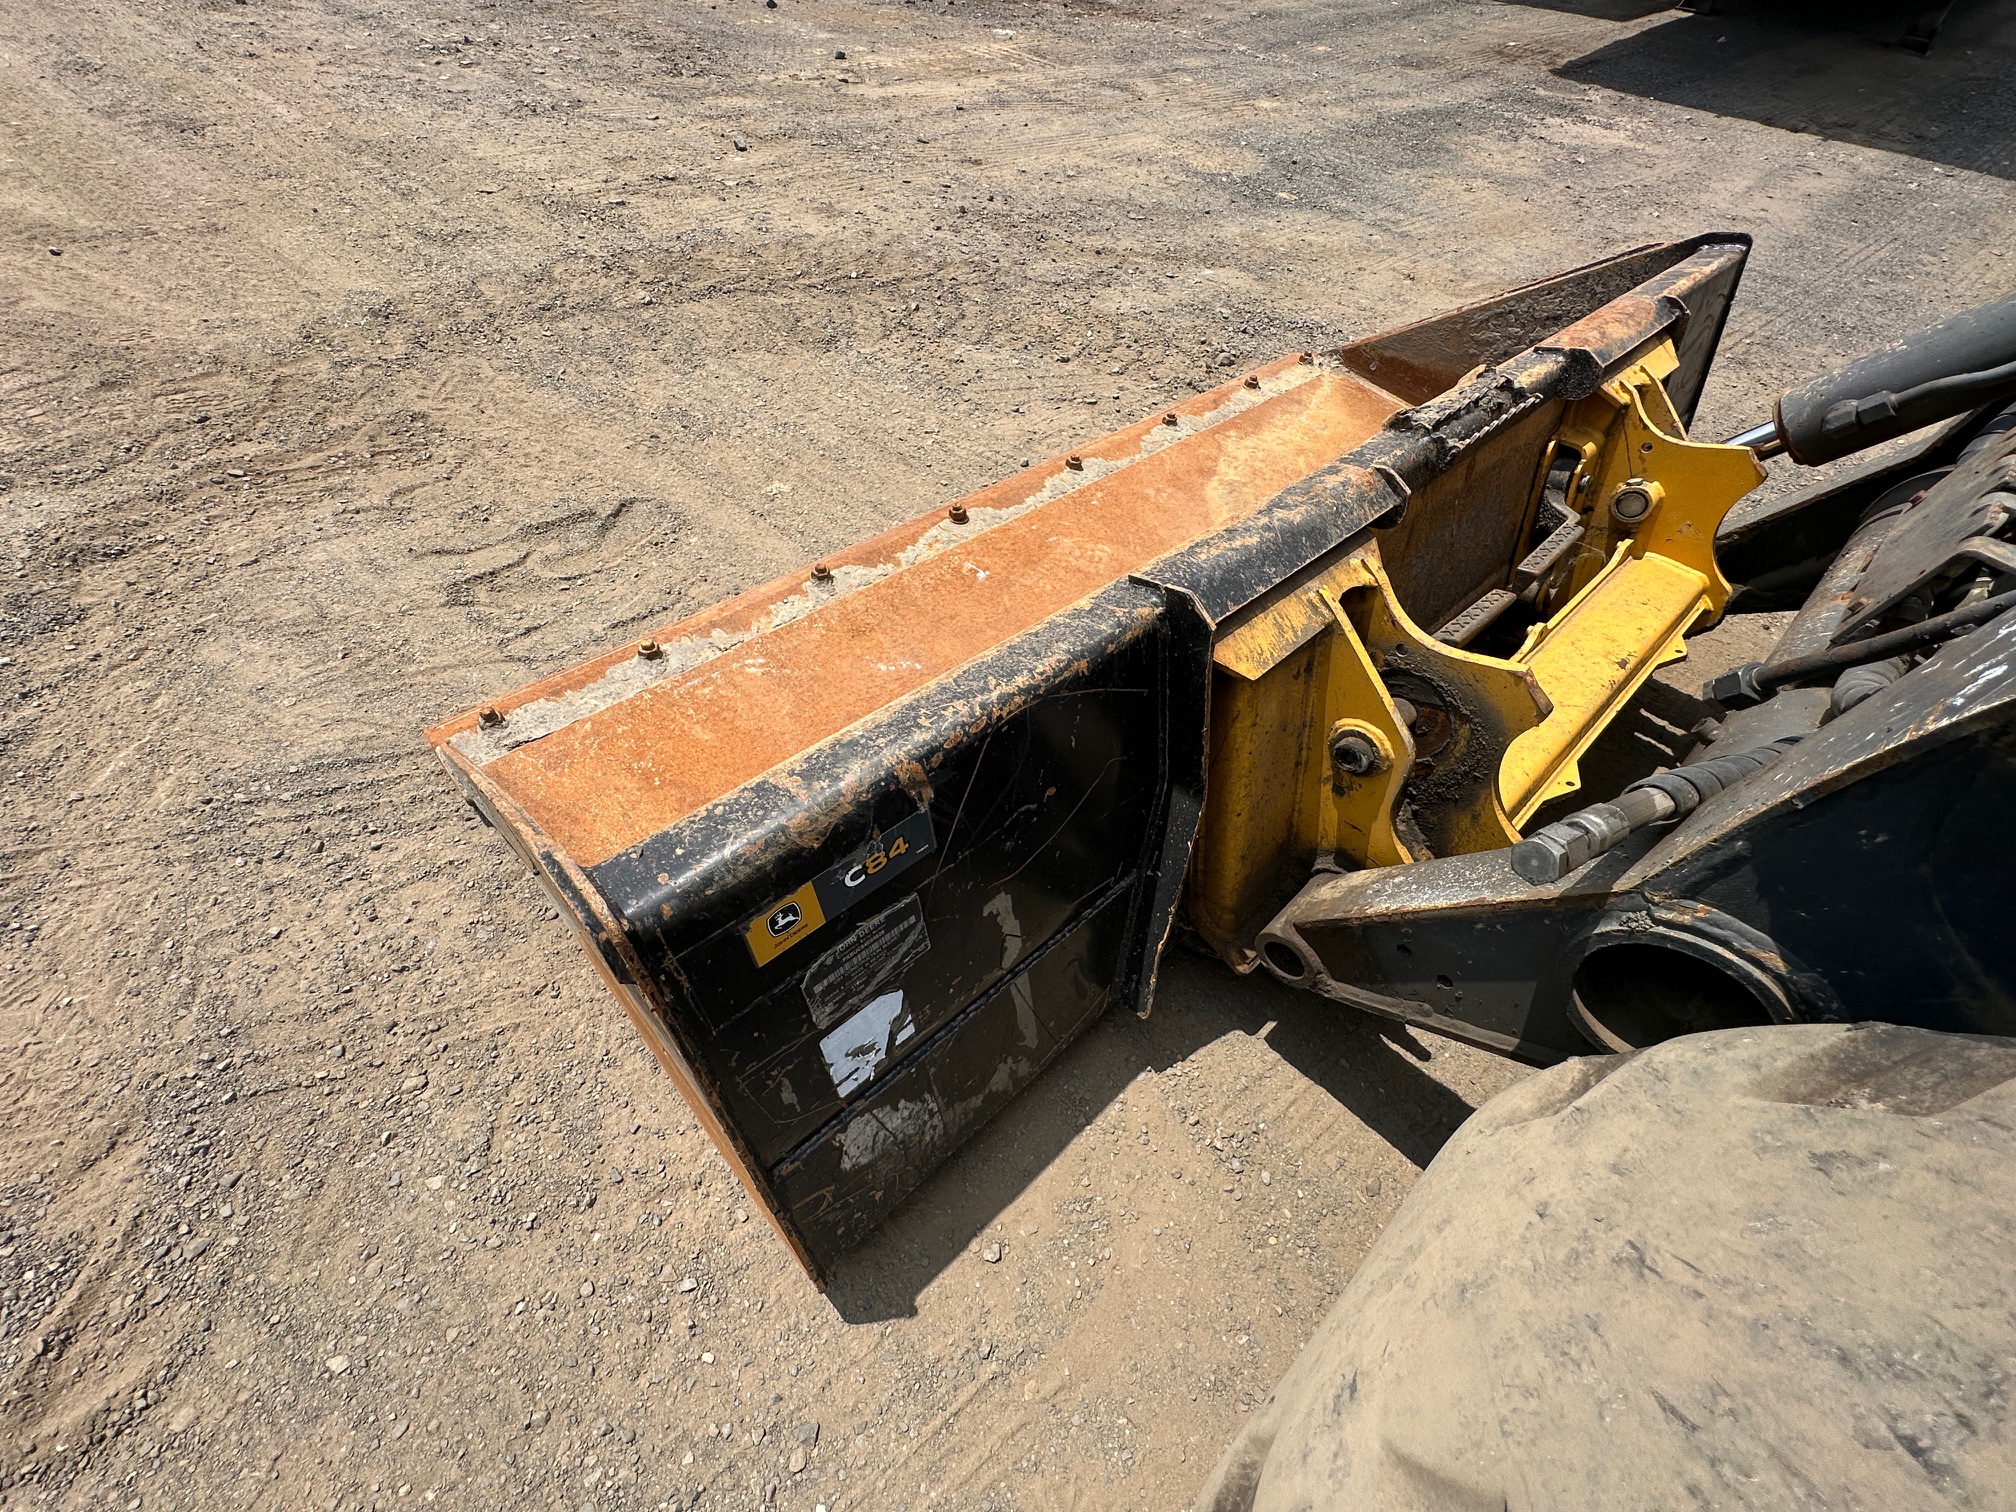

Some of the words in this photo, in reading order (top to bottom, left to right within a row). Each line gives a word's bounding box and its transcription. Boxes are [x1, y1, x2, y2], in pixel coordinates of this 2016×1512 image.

[844, 837, 909, 887] C84
[773, 935, 790, 950] JOHN
[789, 923, 809, 938] DEERE
[836, 936, 857, 954] JOHN
[859, 916, 886, 937] DEERE
